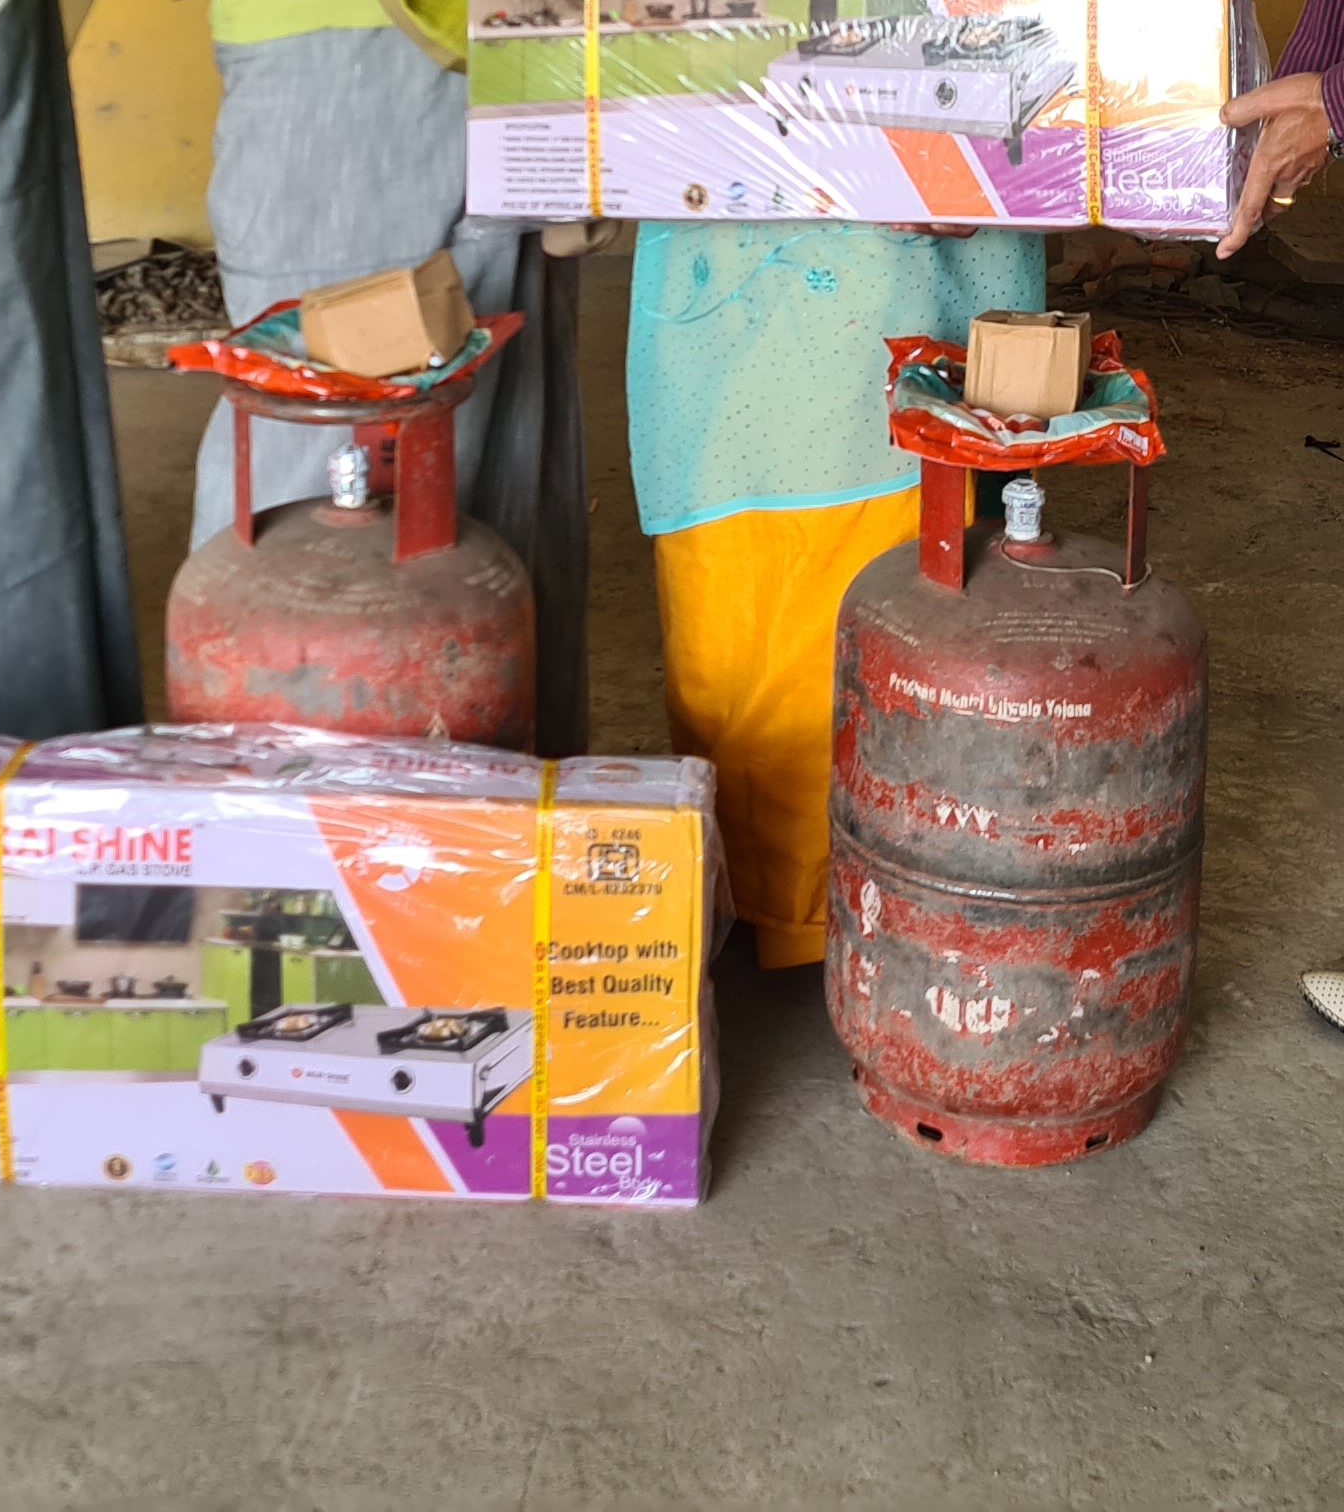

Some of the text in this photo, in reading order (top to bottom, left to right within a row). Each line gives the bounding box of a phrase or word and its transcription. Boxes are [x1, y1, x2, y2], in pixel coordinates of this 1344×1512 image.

[1088, 62, 1098, 82] ISO
[1102, 160, 1174, 196] teel
[1045, 699, 1093, 720] Yojana
[72, 827, 194, 862] SHINE
[548, 941, 628, 963] Cooktop
[635, 940, 679, 959] with
[551, 974, 674, 996] Best Quality
[563, 1008, 660, 1029] Feature...
[568, 1133, 638, 1147] Stainless
[546, 1144, 643, 1177] Steel
